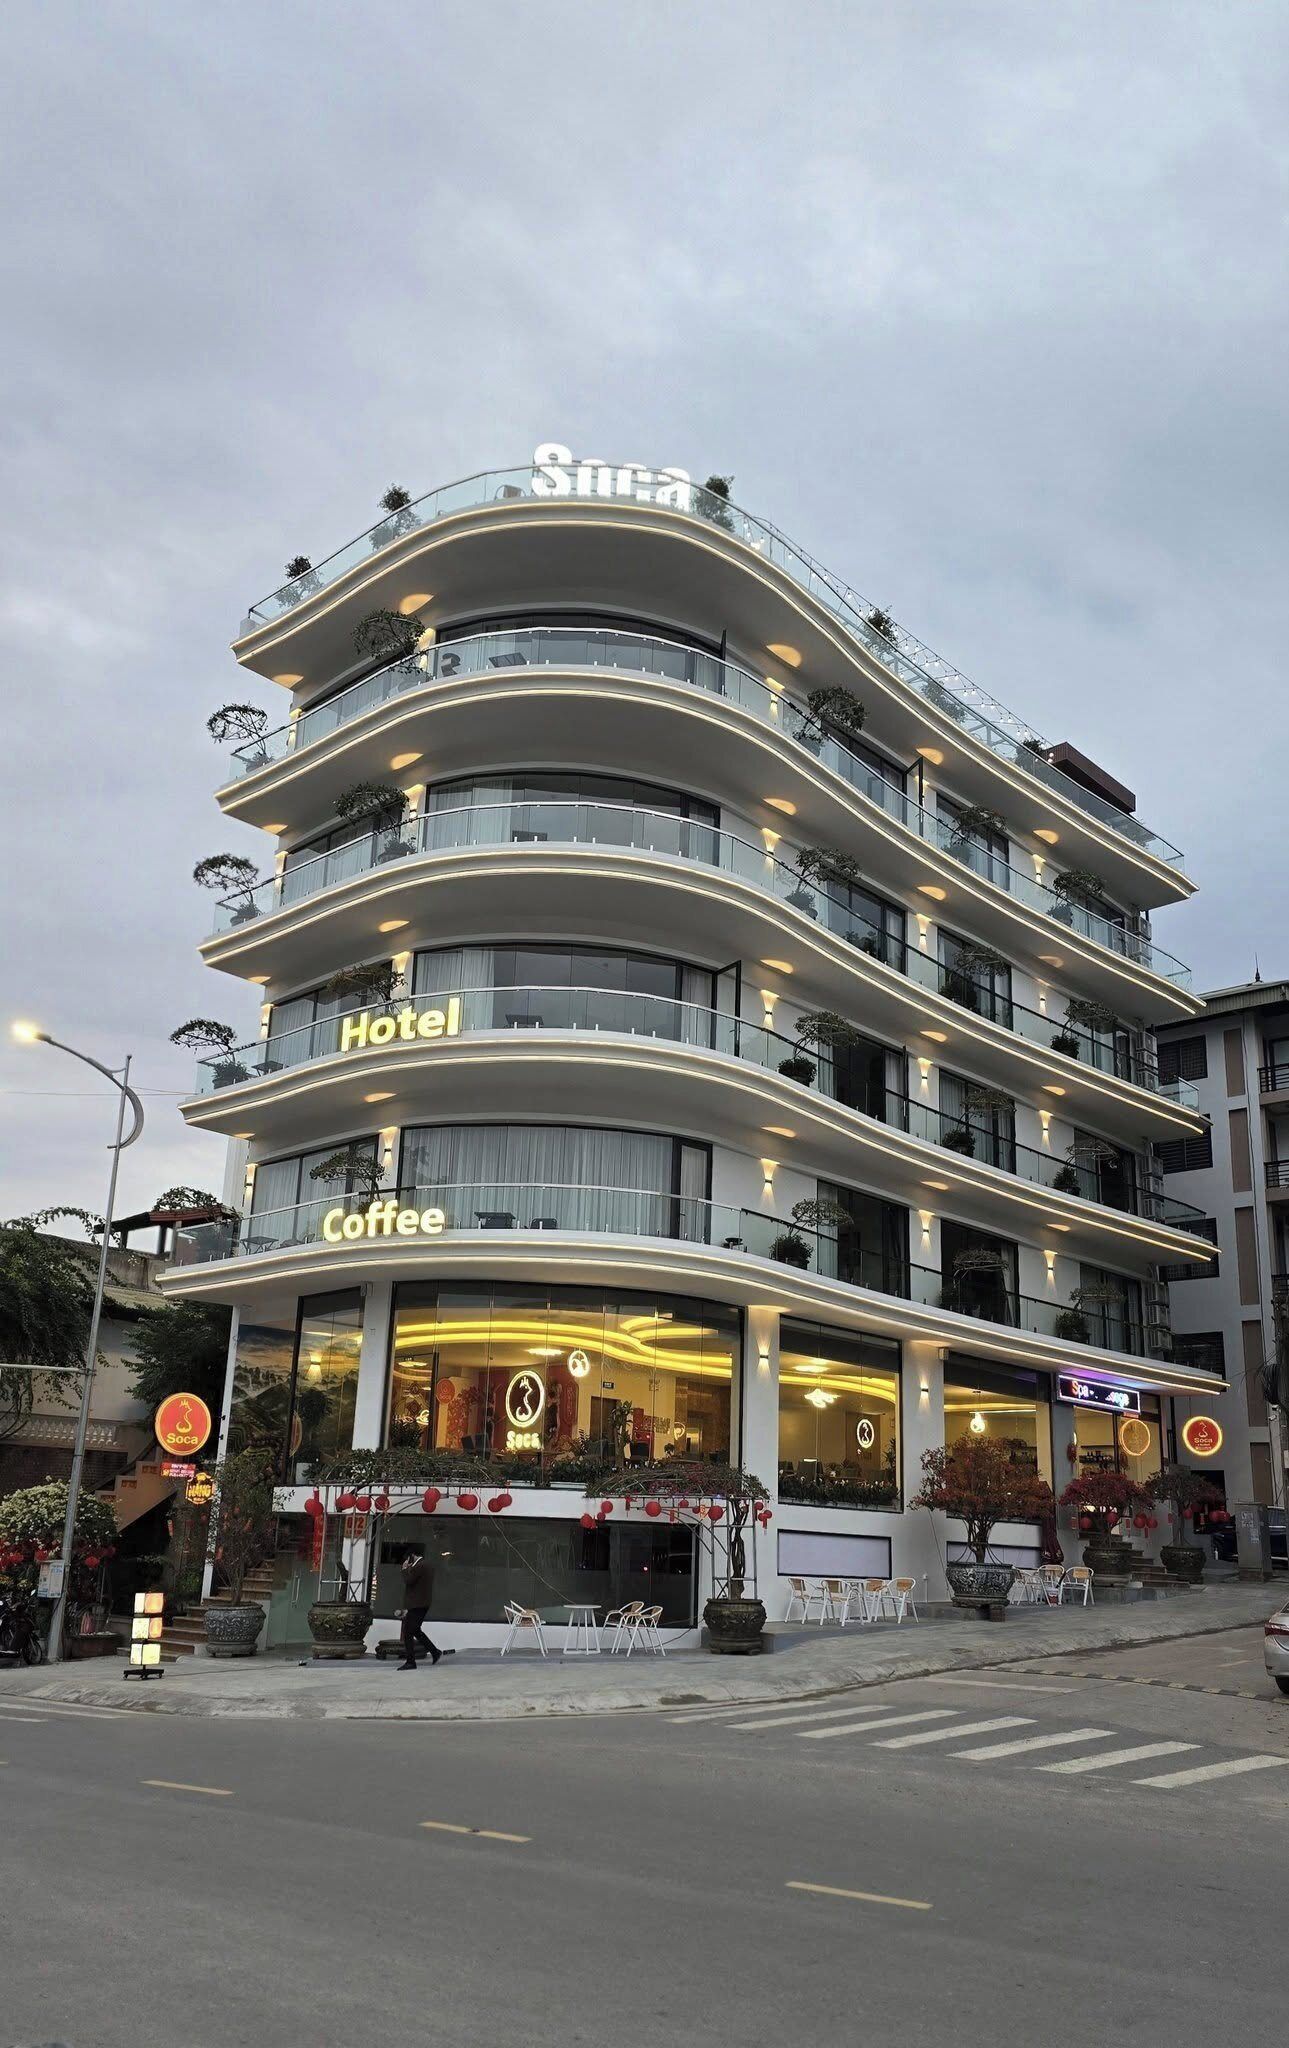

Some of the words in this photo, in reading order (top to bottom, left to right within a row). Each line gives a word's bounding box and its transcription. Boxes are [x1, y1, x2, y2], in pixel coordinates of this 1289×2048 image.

[341, 997, 460, 1051] Hotel
[323, 1199, 445, 1242] Coffee
[1072, 1381, 1089, 1398] Spa
[166, 1433, 199, 1445] Soca
